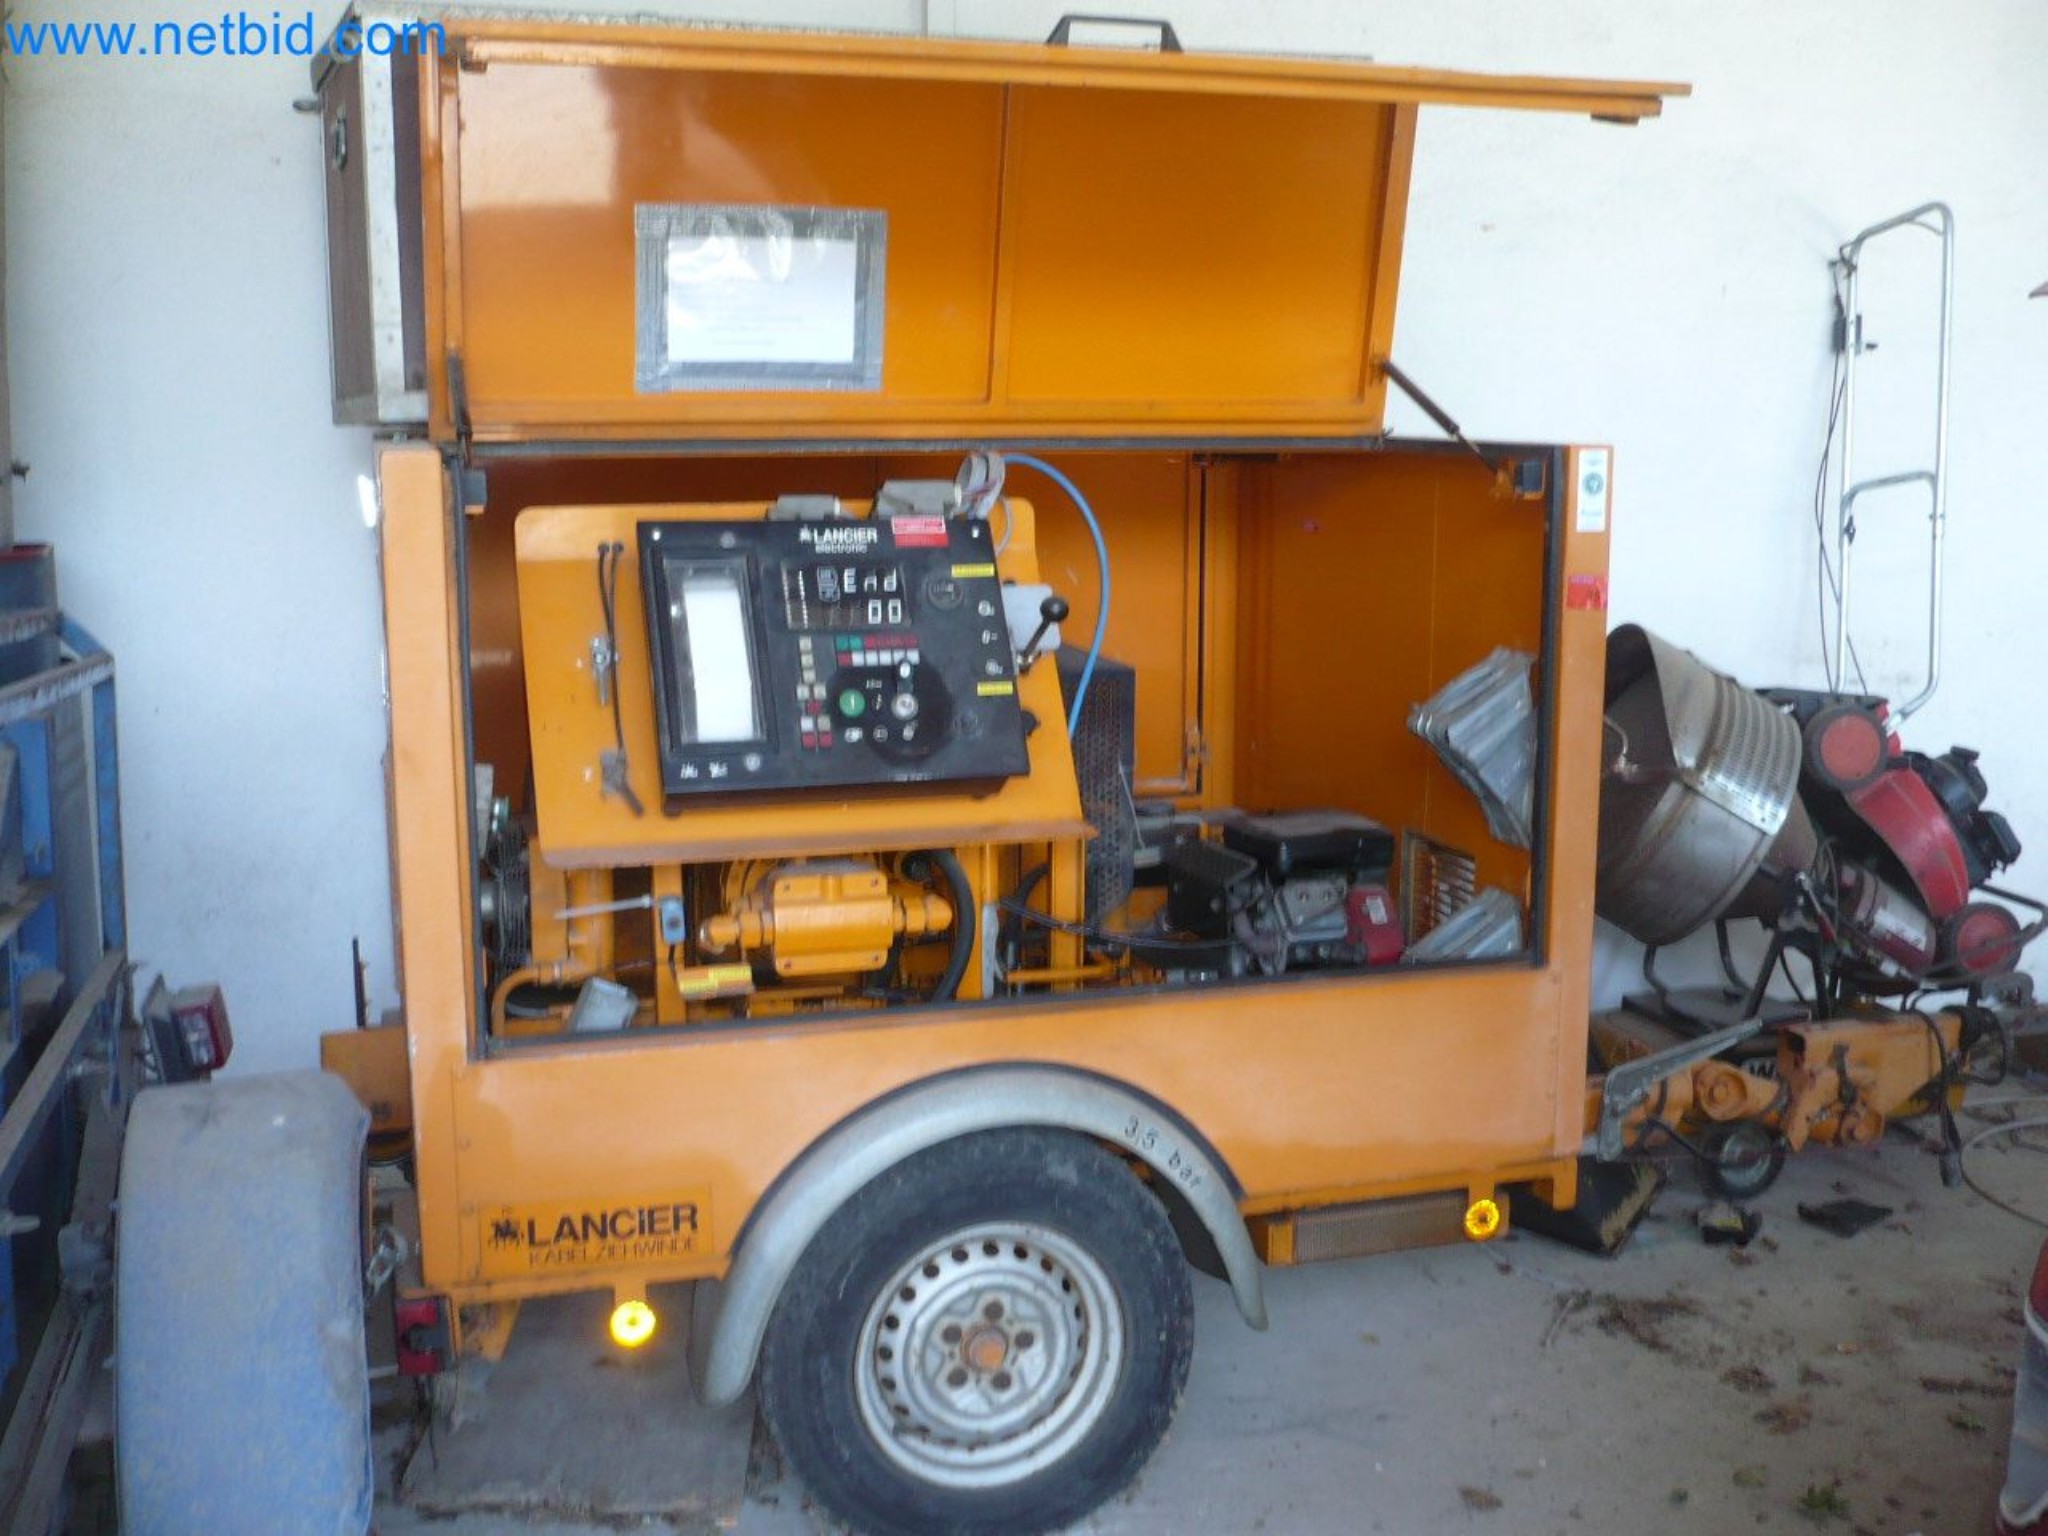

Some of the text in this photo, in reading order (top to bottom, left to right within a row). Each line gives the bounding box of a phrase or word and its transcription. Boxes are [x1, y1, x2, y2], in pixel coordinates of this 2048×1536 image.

[814, 527, 878, 545] LANCIER
[1168, 1149, 1201, 1188] bar
[527, 1204, 698, 1248] LANCIER
